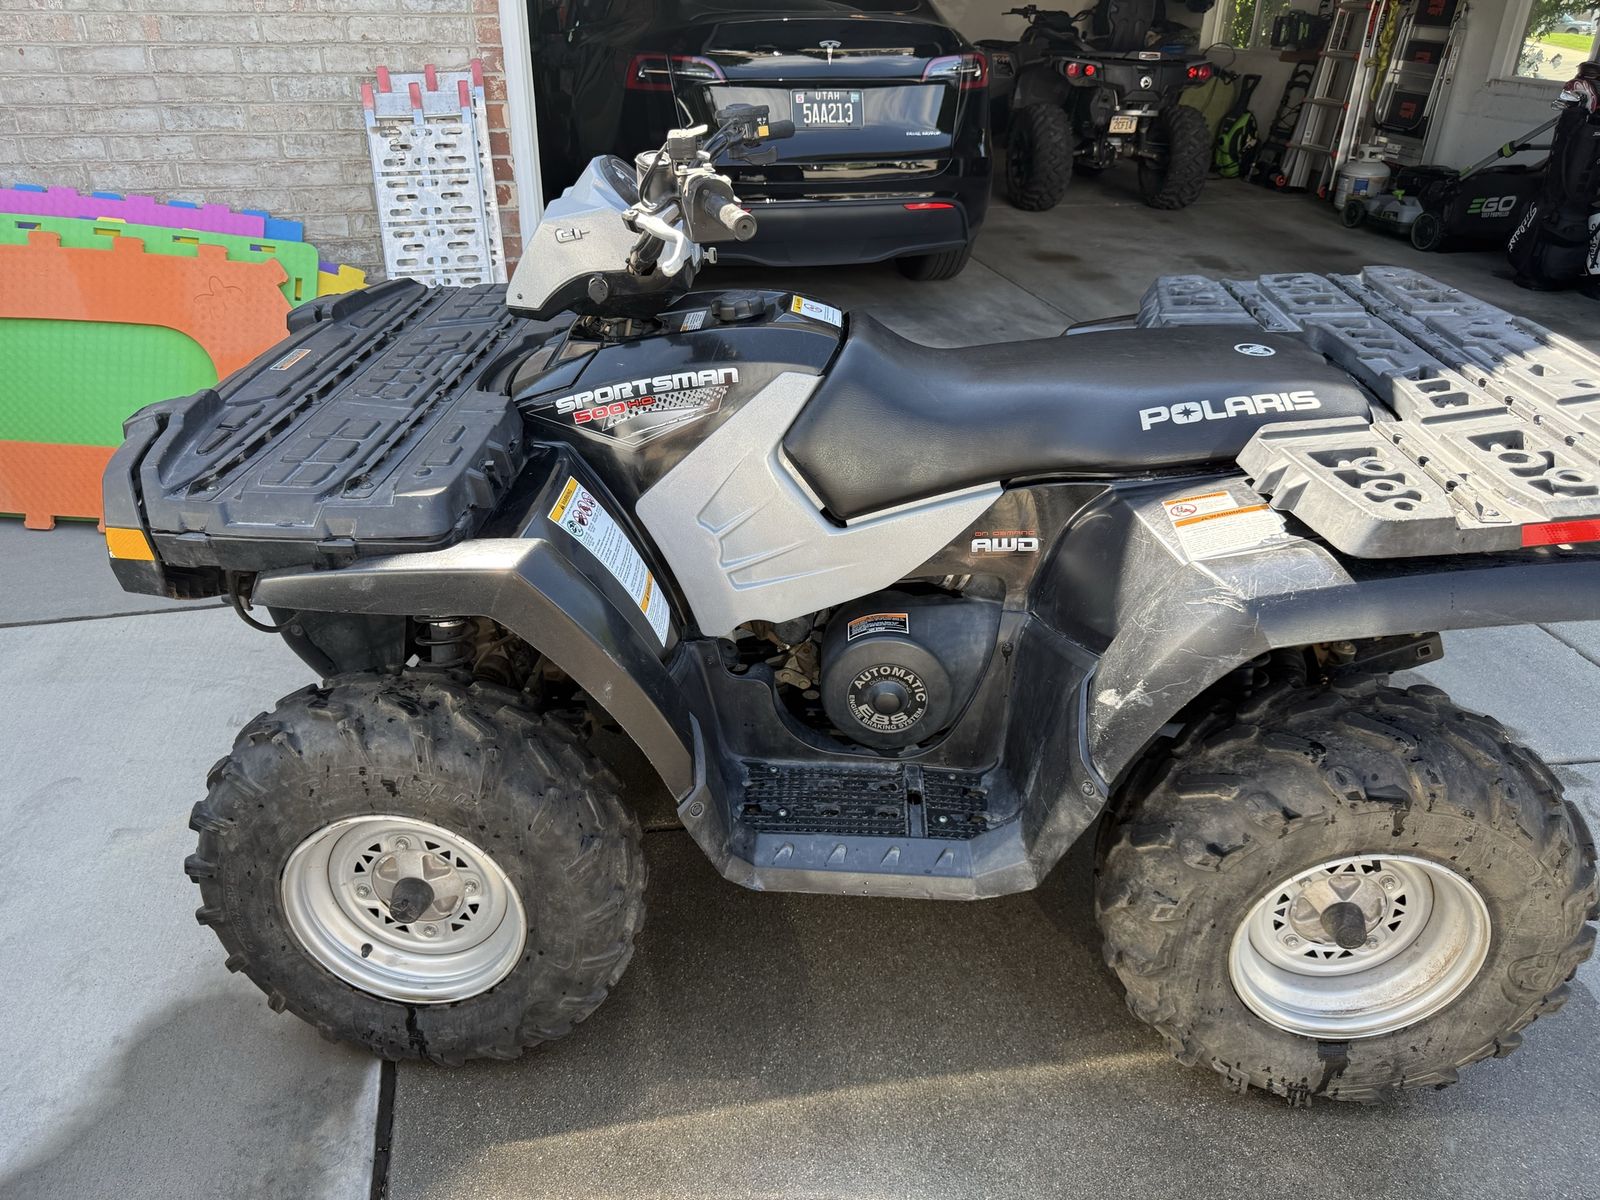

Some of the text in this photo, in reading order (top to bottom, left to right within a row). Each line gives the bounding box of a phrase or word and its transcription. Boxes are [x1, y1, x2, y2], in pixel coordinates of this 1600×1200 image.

[815, 92, 840, 100] UTAH
[803, 103, 853, 124] 5AA213
[1467, 196, 1516, 214] EGO
[555, 367, 739, 415] SPORTSMAN
[573, 402, 626, 425] 500
[1139, 390, 1322, 431] POLARIS
[971, 537, 1039, 553] AWD
[854, 666, 926, 702] AUTOMATIC
[849, 695, 924, 730] ENGINE BRAKING SYSTEM
[858, 704, 909, 725] EBS
